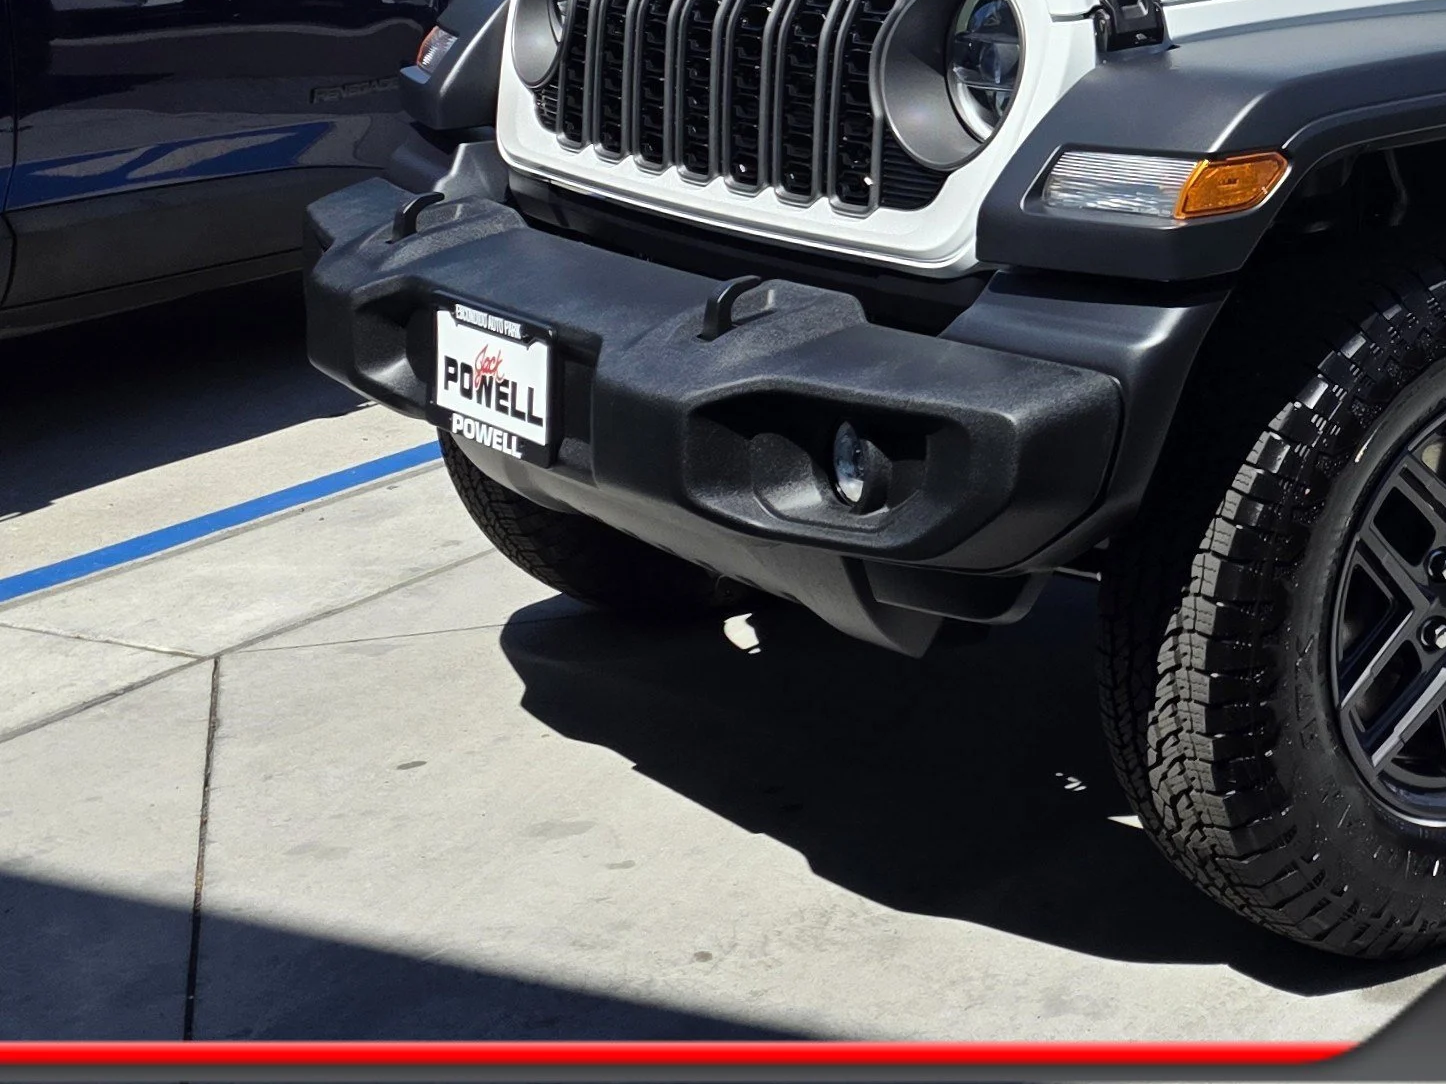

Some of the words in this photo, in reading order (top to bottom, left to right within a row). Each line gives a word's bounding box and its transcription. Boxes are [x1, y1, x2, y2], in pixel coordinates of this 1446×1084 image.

[443, 354, 545, 428] POWELL
[474, 344, 505, 390] Jack
[451, 412, 523, 460] POWELL
